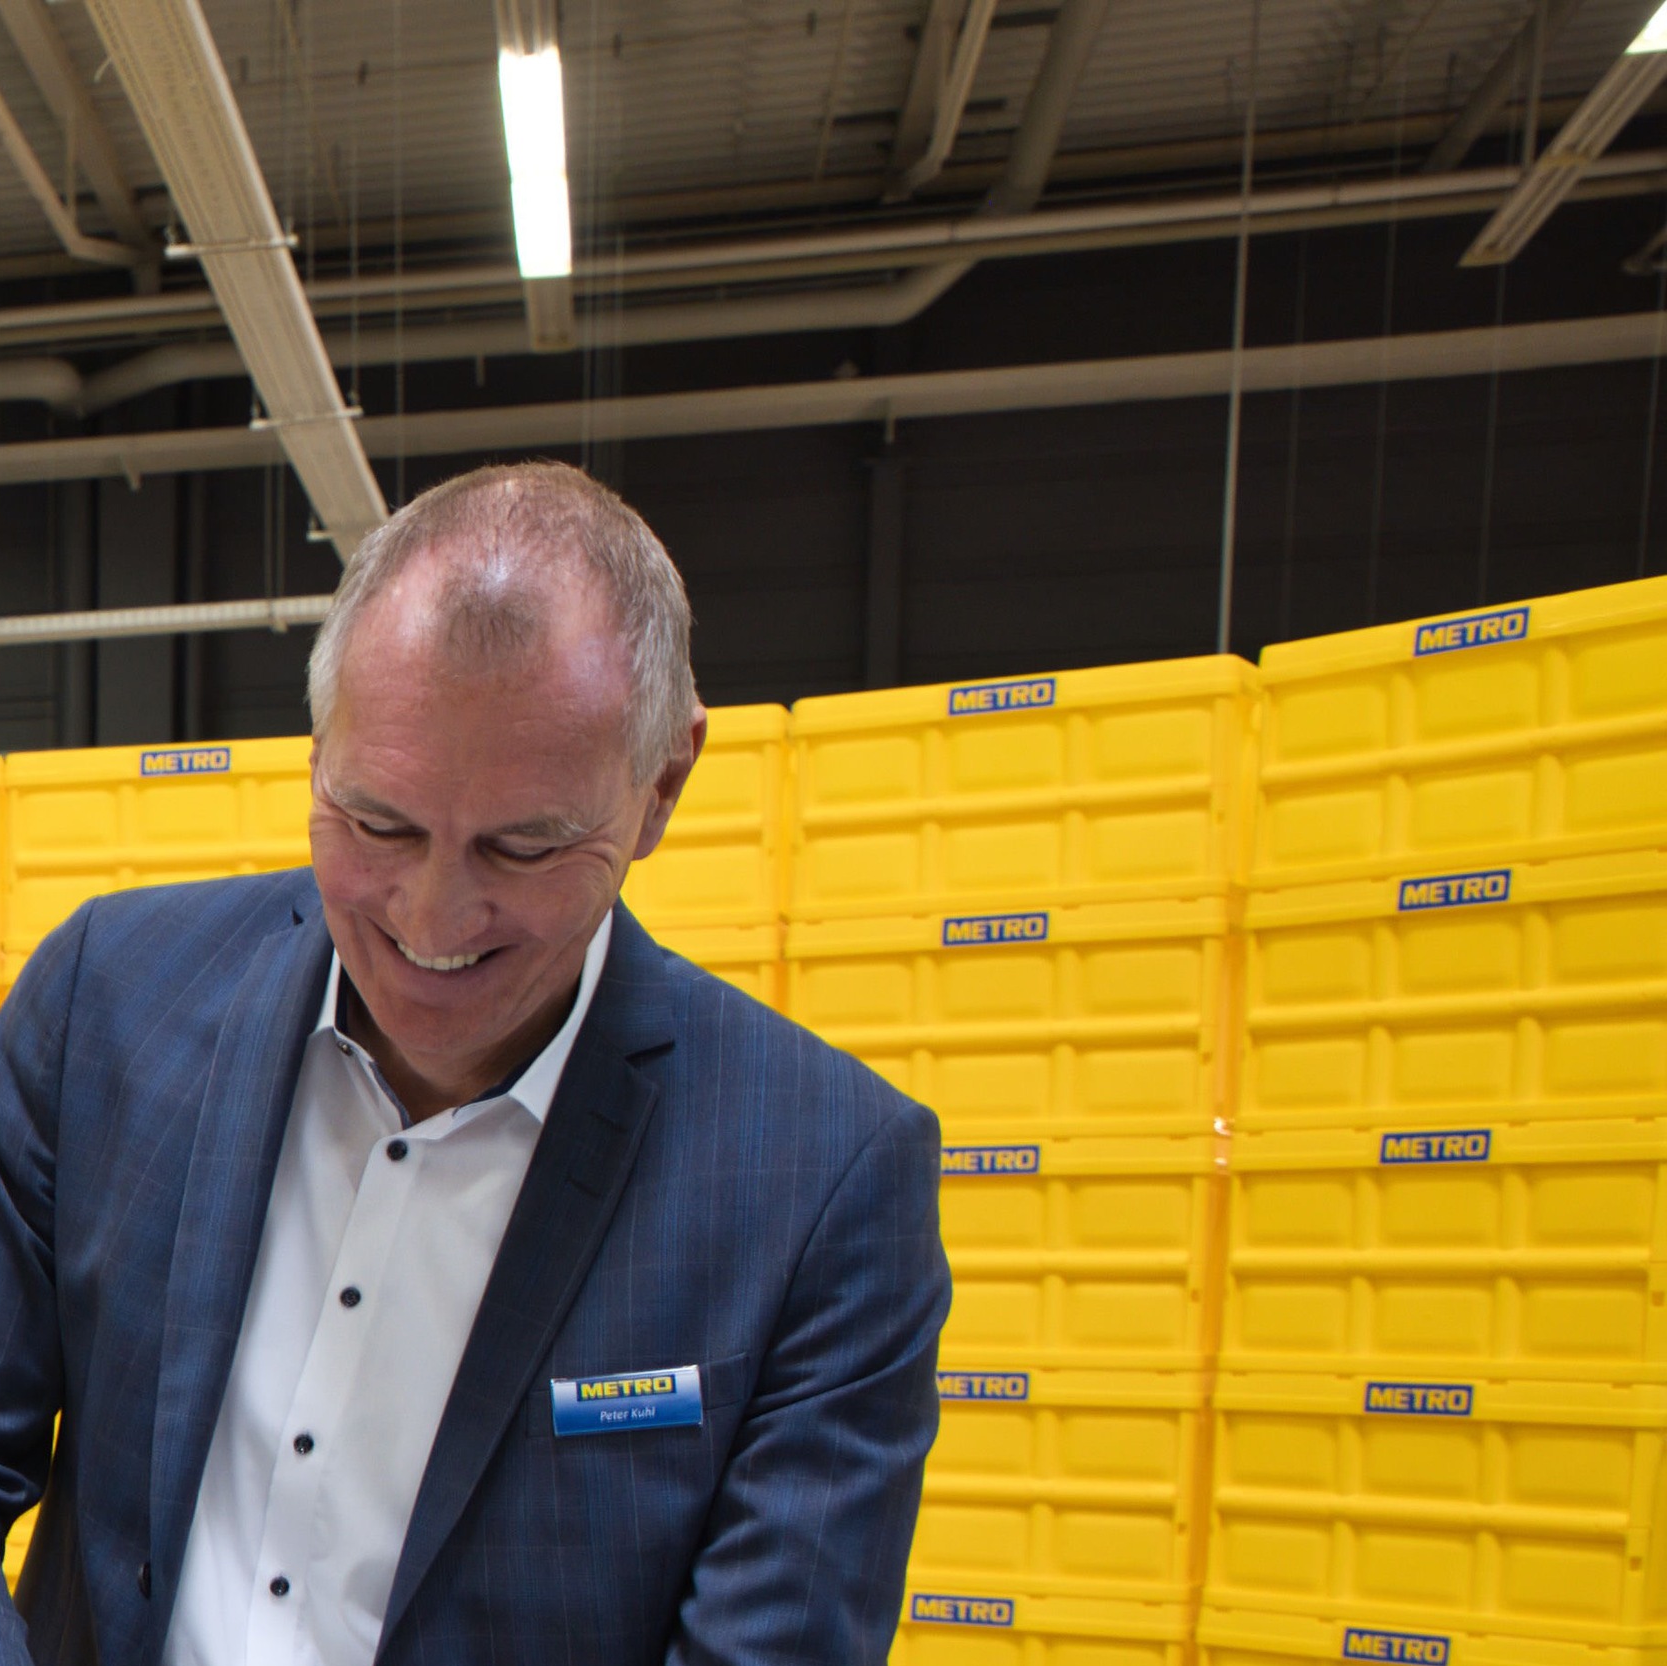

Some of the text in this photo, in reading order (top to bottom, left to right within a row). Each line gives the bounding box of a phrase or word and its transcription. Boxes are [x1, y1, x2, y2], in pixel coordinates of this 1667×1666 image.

[1419, 611, 1525, 651] METRO
[953, 682, 1052, 710] METRO
[144, 750, 228, 771] METRO
[1403, 873, 1506, 906] METRO
[947, 915, 1044, 942] METRO
[942, 1149, 1036, 1170] METRO
[1385, 1133, 1487, 1160] METRO
[580, 1375, 673, 1400] METRO
[937, 1374, 1025, 1396] METRO
[1369, 1385, 1469, 1412] METRO
[600, 1409, 629, 1422] Peter
[916, 1597, 1010, 1623] METRO
[1348, 1631, 1446, 1663] METRO
